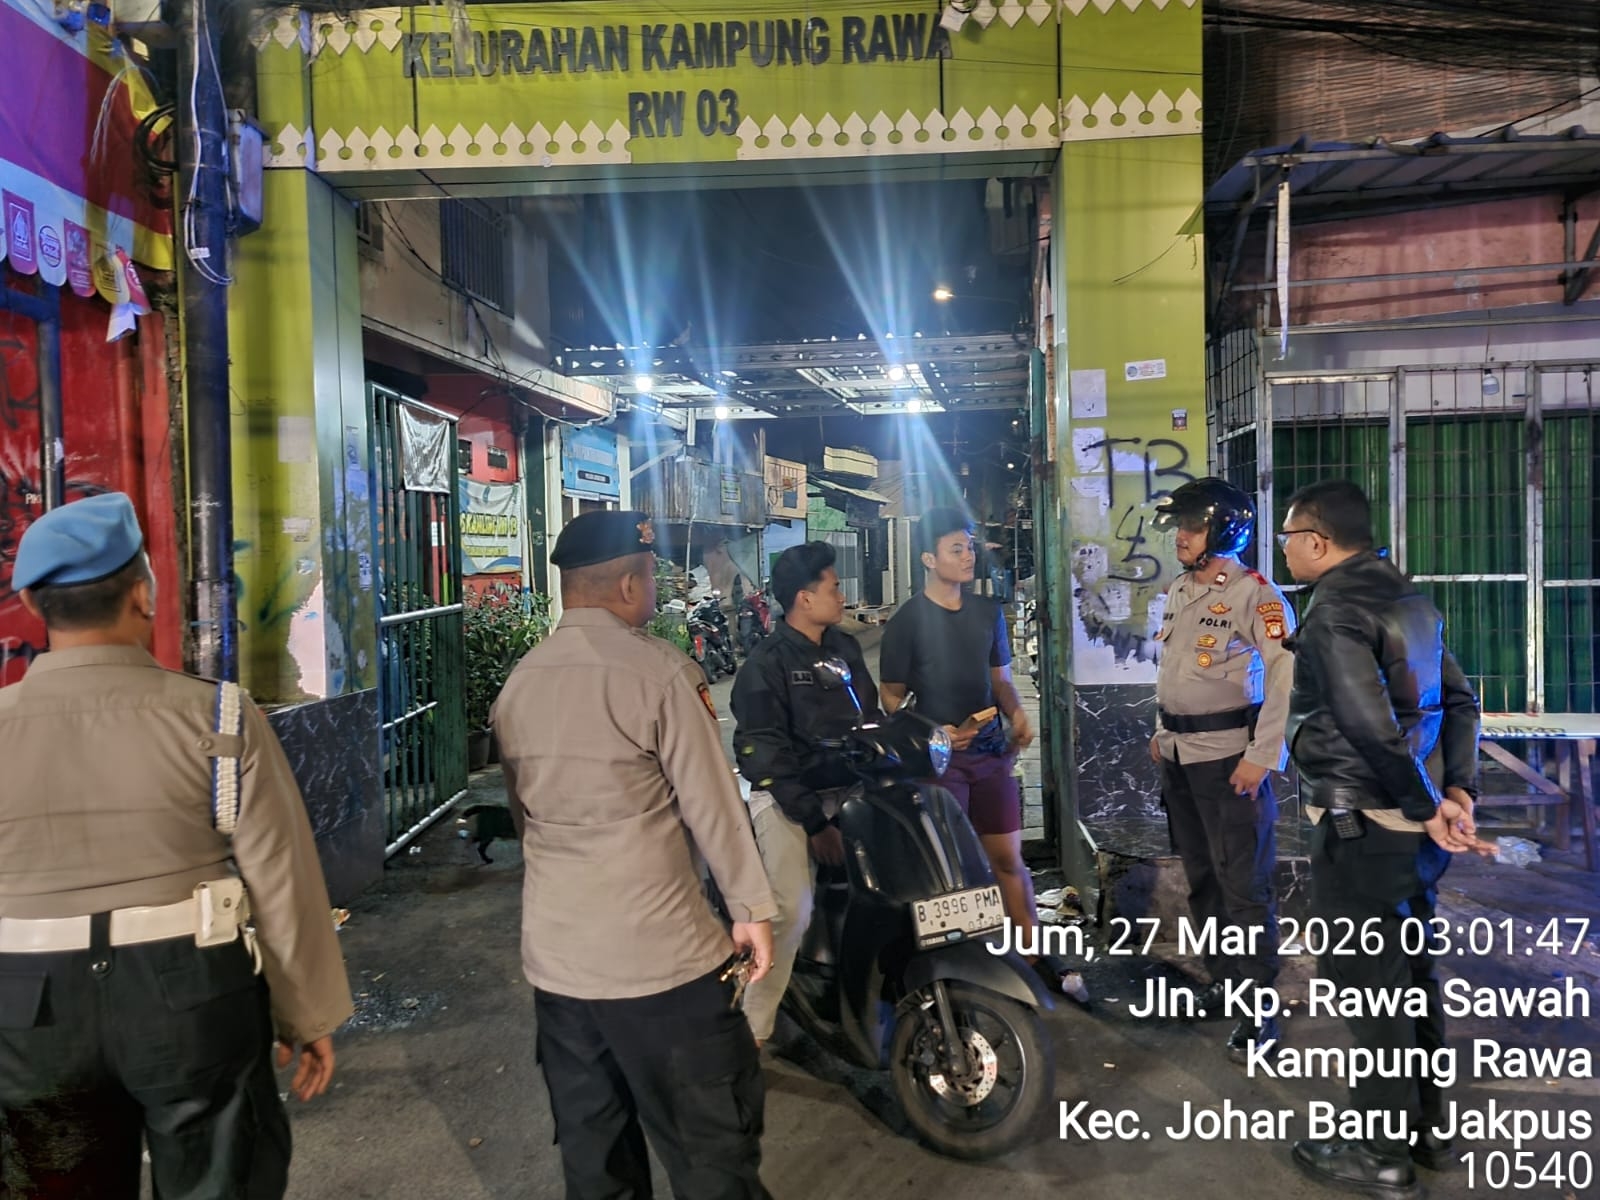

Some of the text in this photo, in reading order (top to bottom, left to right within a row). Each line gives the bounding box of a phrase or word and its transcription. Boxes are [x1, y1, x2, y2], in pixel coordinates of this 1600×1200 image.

[402, 12, 954, 79] KELURAHAN KAMPUNG RAWA
[628, 88, 740, 138] RW 03
[1198, 617, 1232, 629] POLRI
[917, 888, 1000, 922] B 3996 PMA
